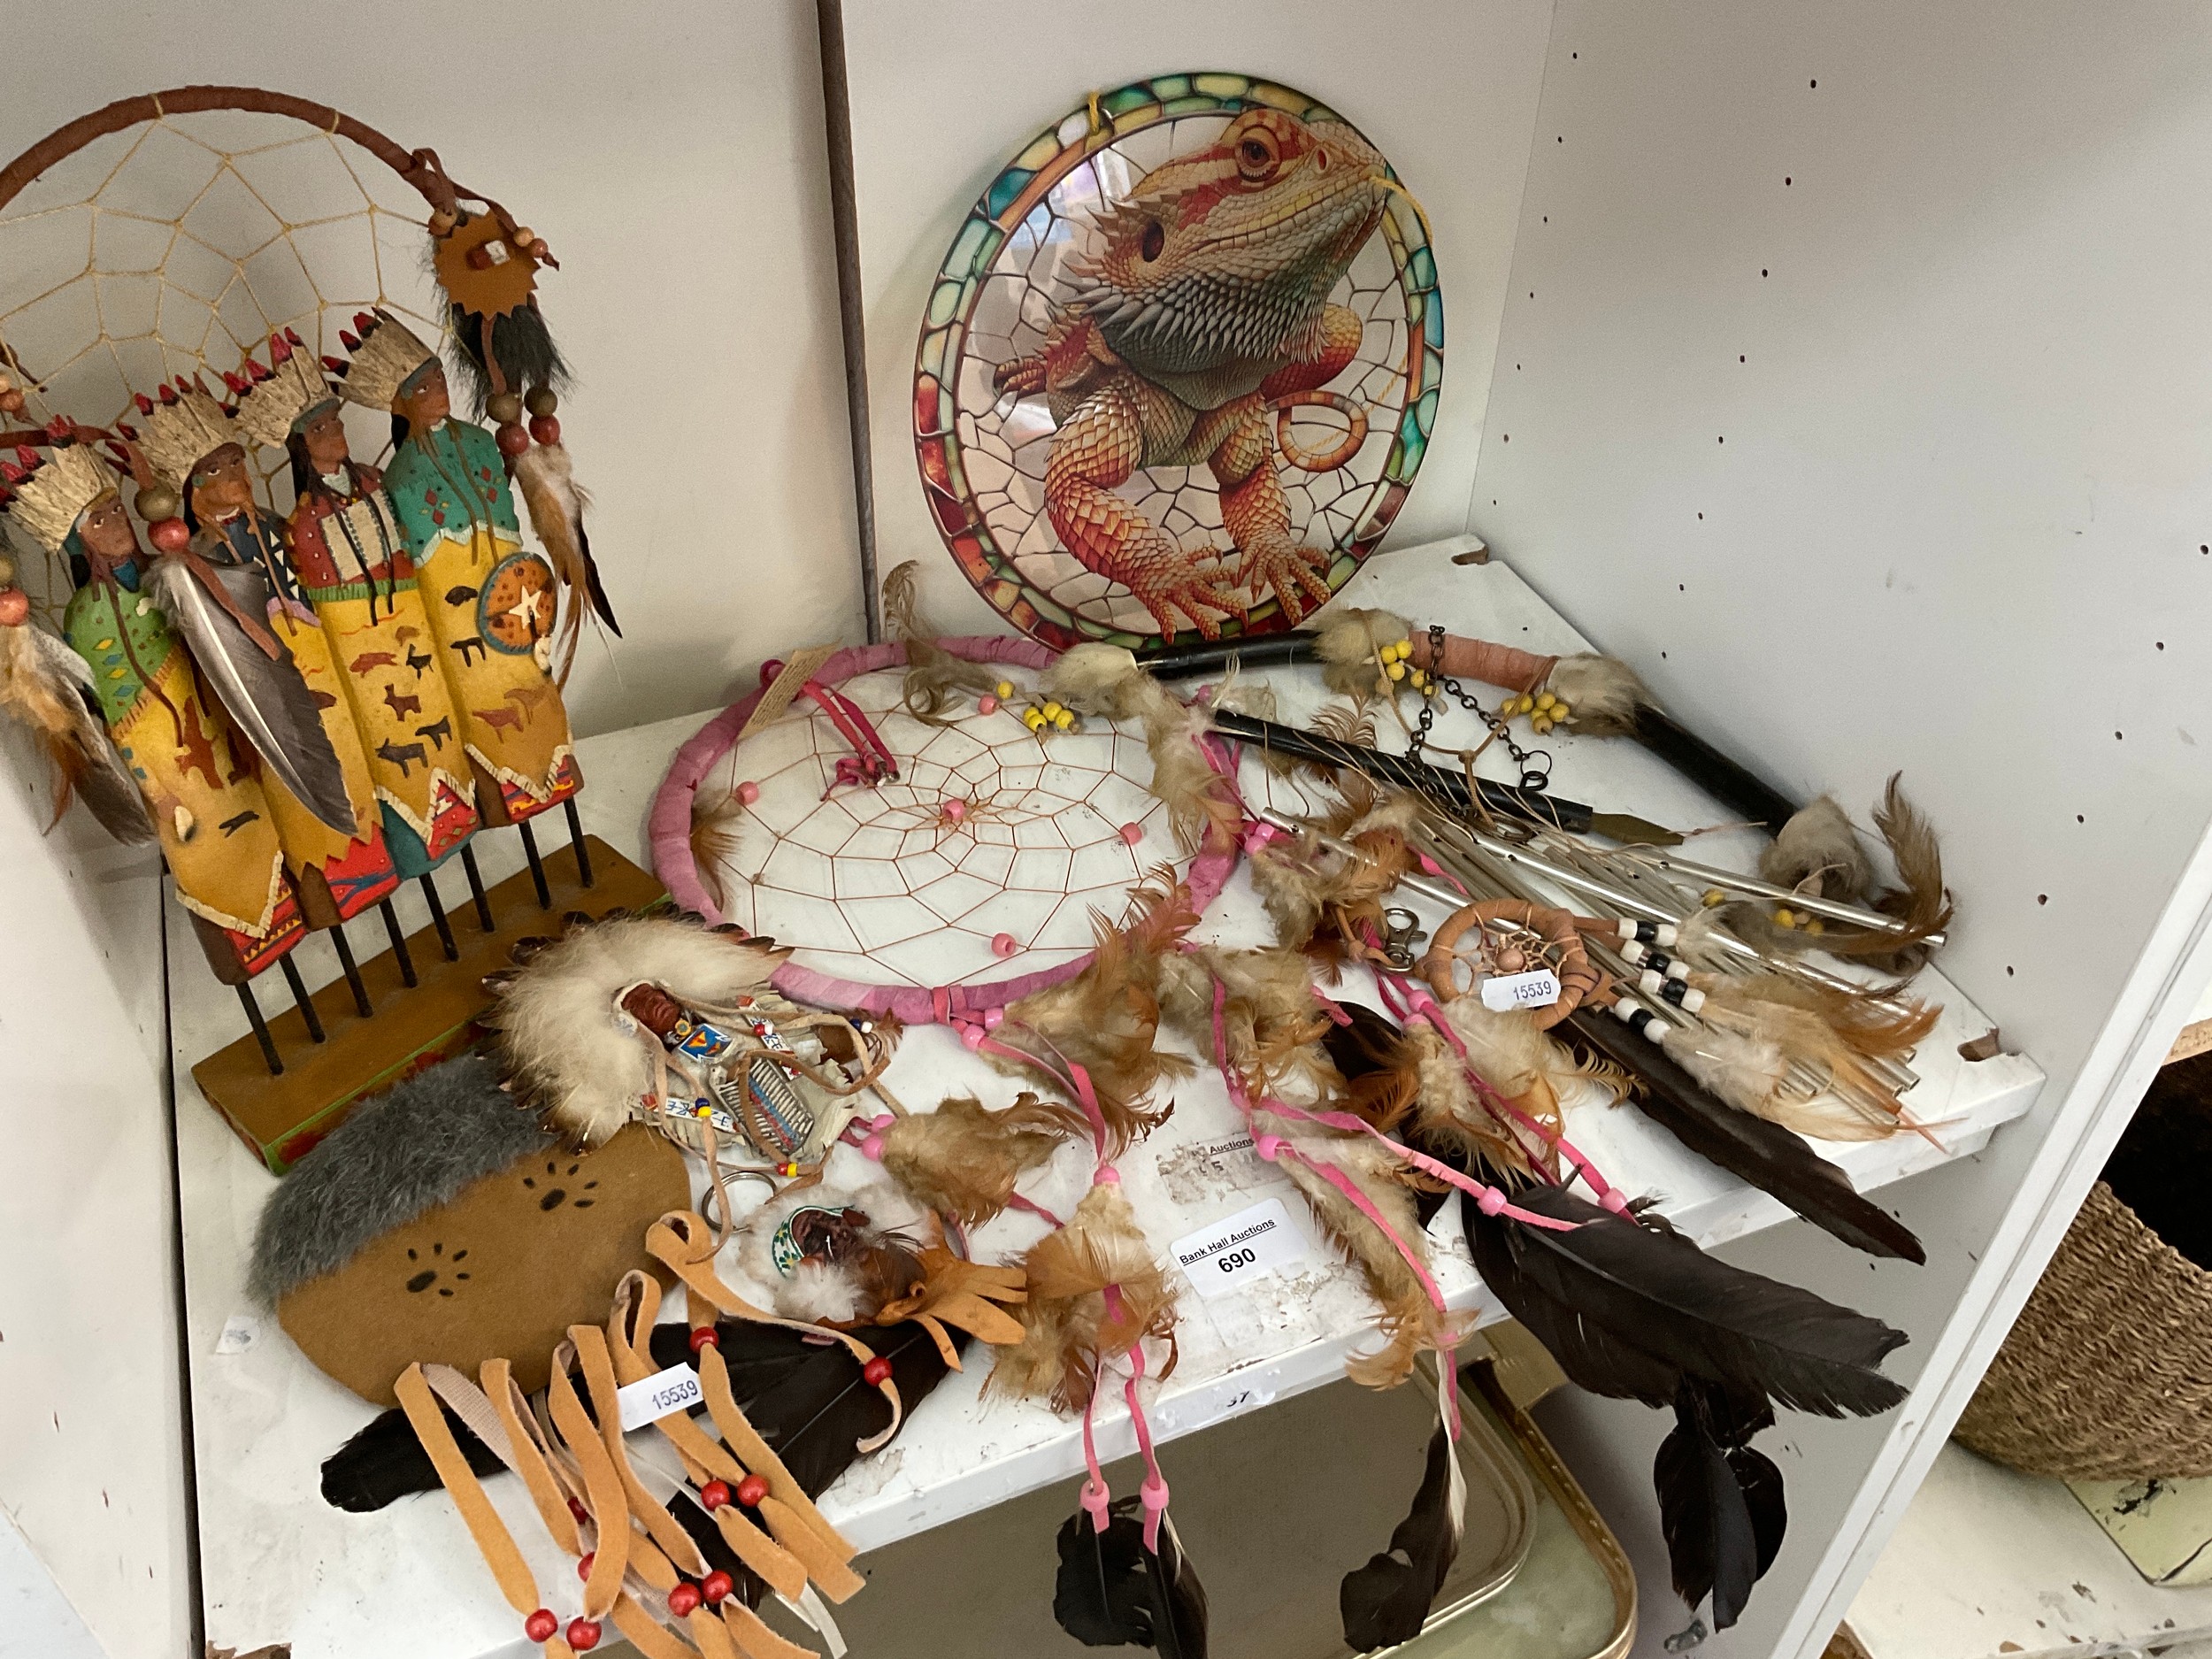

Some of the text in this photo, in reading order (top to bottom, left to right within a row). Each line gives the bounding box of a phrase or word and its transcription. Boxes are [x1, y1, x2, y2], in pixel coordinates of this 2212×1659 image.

[1513, 980, 1552, 1001] 15539
[1210, 1137, 1255, 1155] Auctions
[1179, 1218, 1275, 1264] Bank Hall Auctions
[1217, 1248, 1256, 1273] 690
[652, 1380, 697, 1409] 15539
